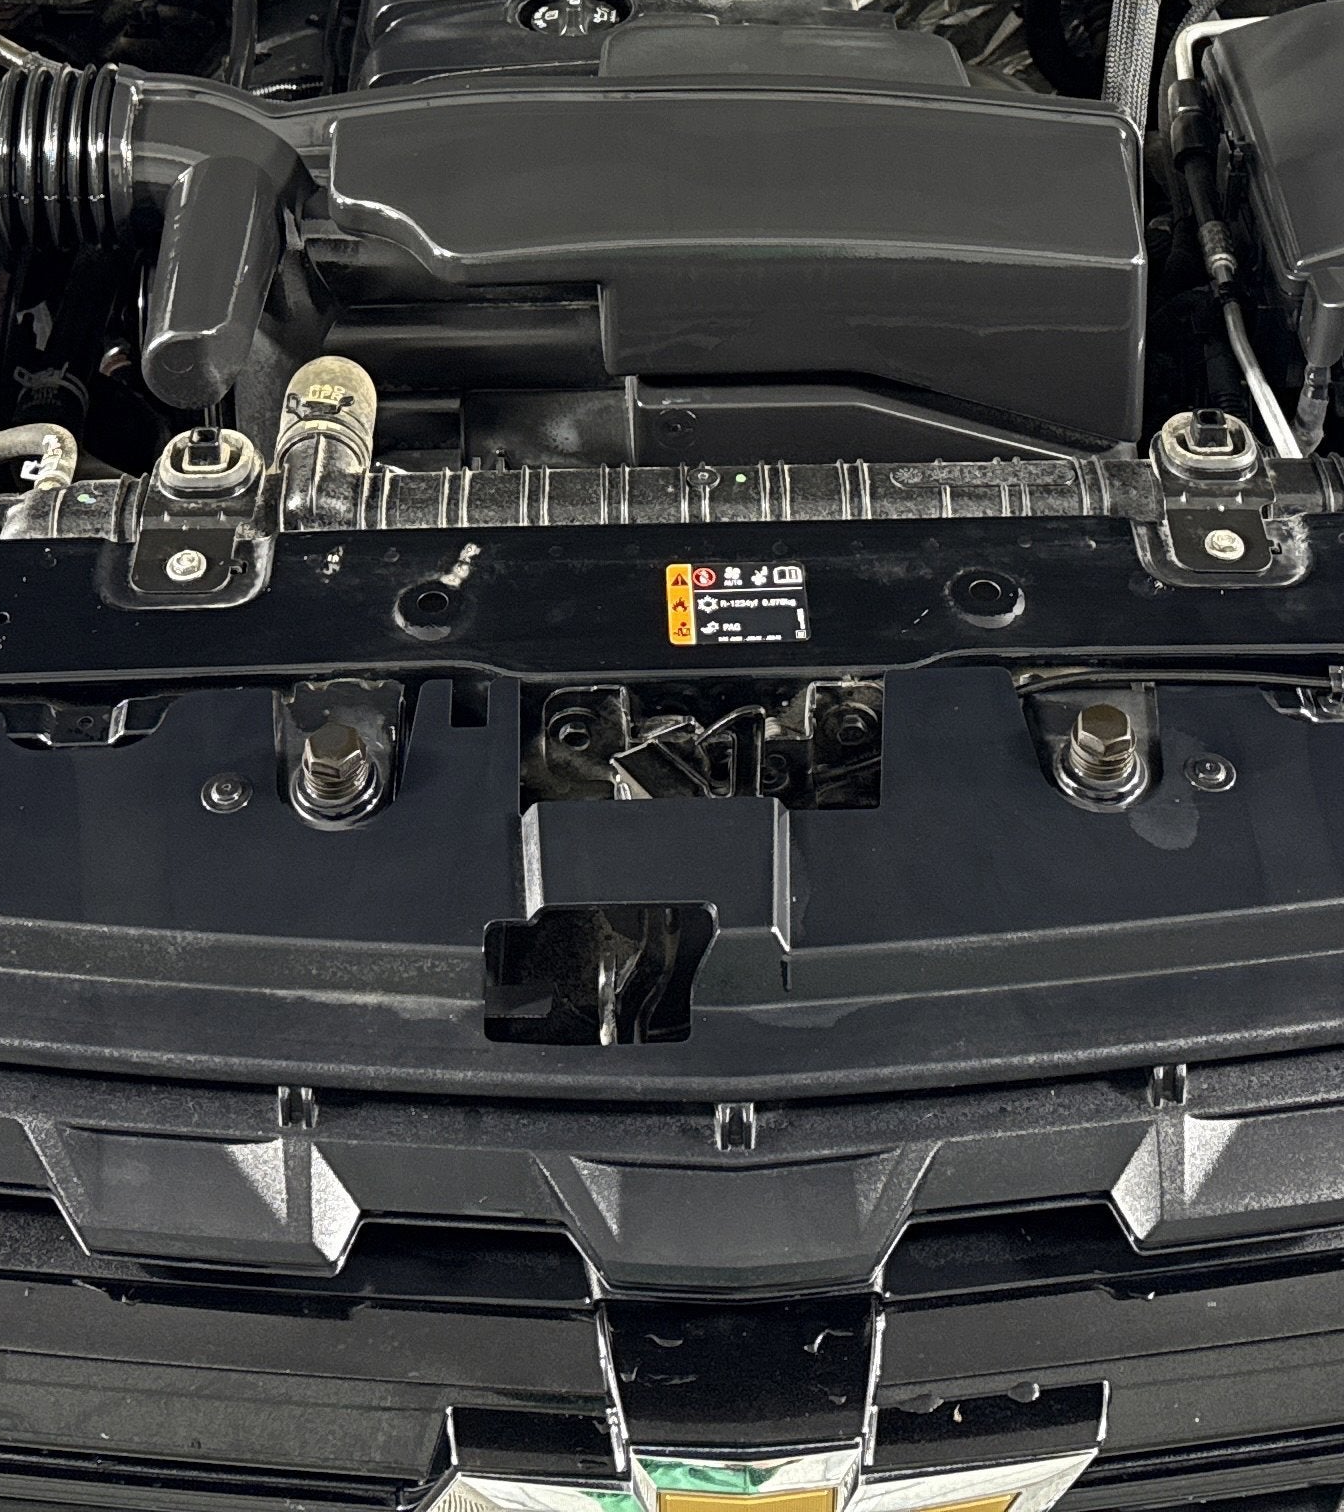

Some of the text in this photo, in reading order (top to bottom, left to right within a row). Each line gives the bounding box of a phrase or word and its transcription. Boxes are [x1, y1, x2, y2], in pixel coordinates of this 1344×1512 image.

[723, 579, 743, 587] AUTO
[719, 599, 759, 608] R-1234yf
[722, 622, 742, 632] PAG
